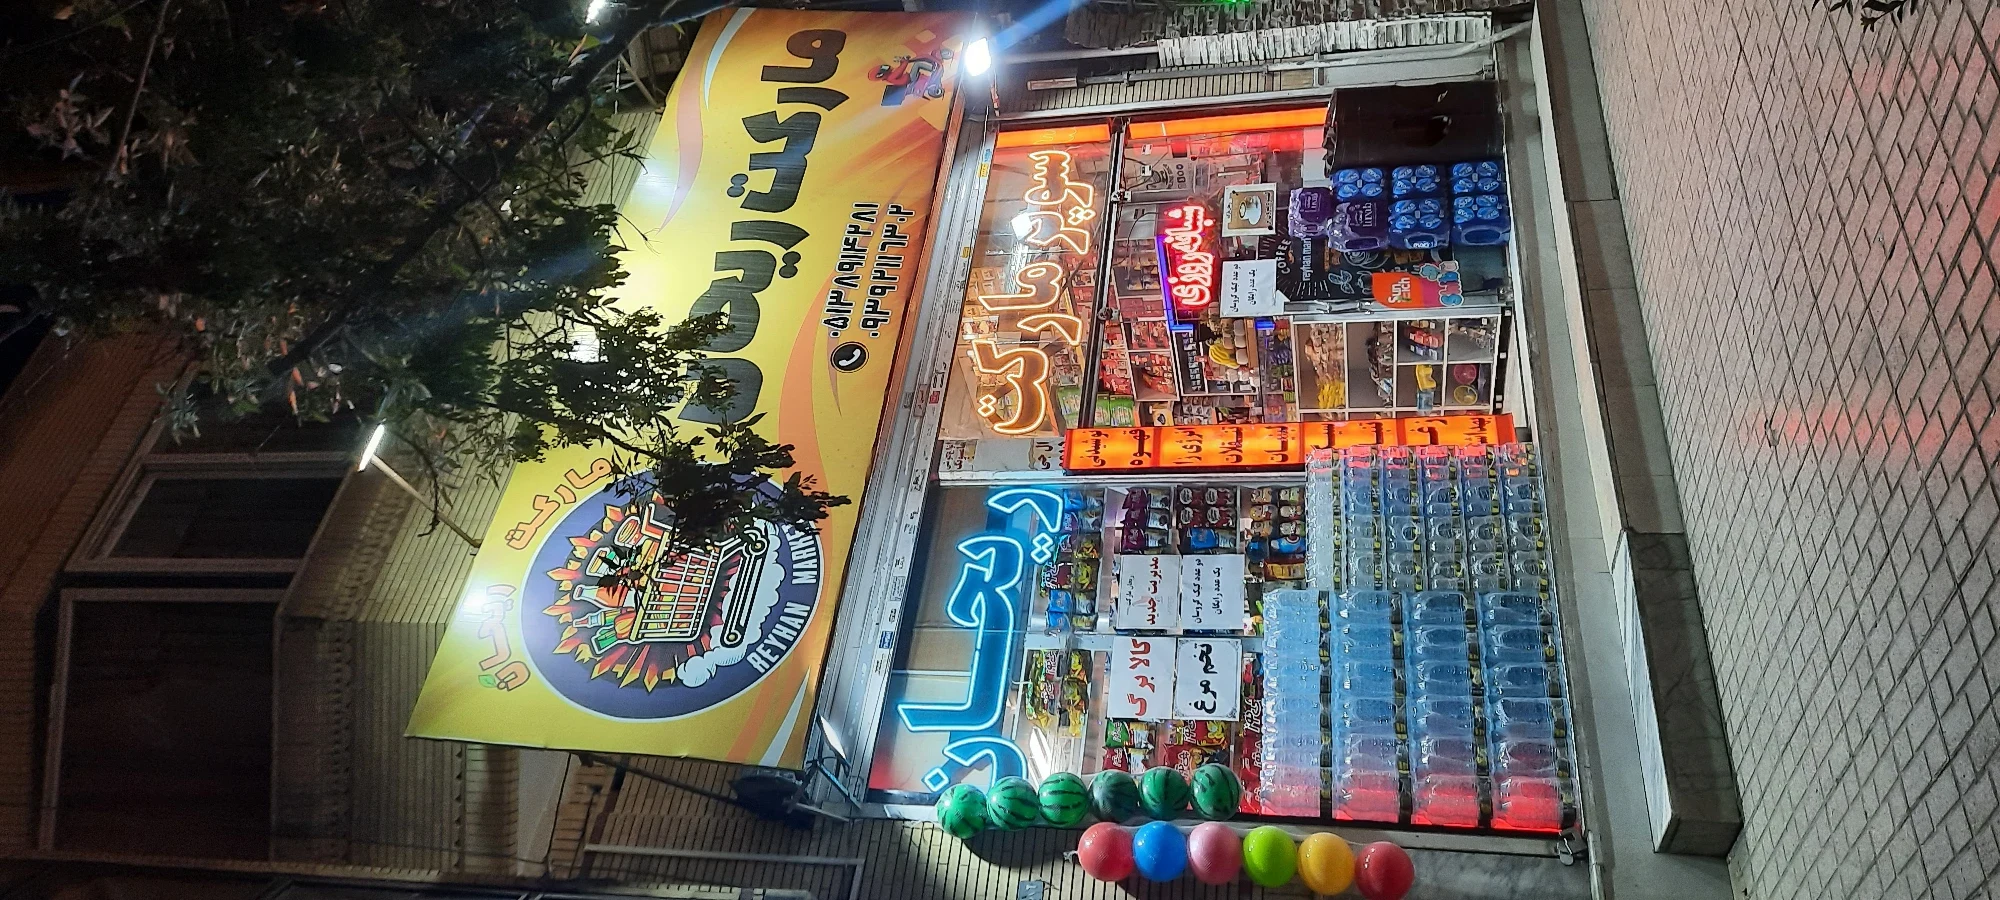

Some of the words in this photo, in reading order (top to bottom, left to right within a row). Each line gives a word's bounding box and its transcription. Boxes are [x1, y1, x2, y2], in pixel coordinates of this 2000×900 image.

[726, 28, 849, 214] مارکت
[1022, 150, 1097, 254] سوپر
[1276, 238, 1292, 274] COFFEE
[1300, 255, 1313, 281] reyhan
[971, 261, 1083, 436] مارکت
[1080, 430, 1109, 467] نوشیدنی
[1123, 429, 1151, 466] قهوه
[1218, 426, 1243, 463] تنقلات
[504, 455, 612, 550] مارکت
[1147, 556, 1162, 594] مدیریت
[1194, 558, 1204, 567] دو
[1194, 568, 1202, 581] عدد
[1213, 567, 1223, 577] یک
[1193, 582, 1202, 598] کیک
[1212, 593, 1223, 615] رایگان
[1146, 597, 1161, 625] جدید
[1192, 599, 1203, 624] کروسان
[477, 582, 531, 691] ریحان
[746, 601, 812, 673] REYHAN
[896, 487, 1064, 793] ریحان
[1128, 638, 1151, 670] کالا
[1193, 643, 1218, 674] تخم
[1127, 675, 1155, 716] برگ
[1188, 679, 1217, 714] مرغ
